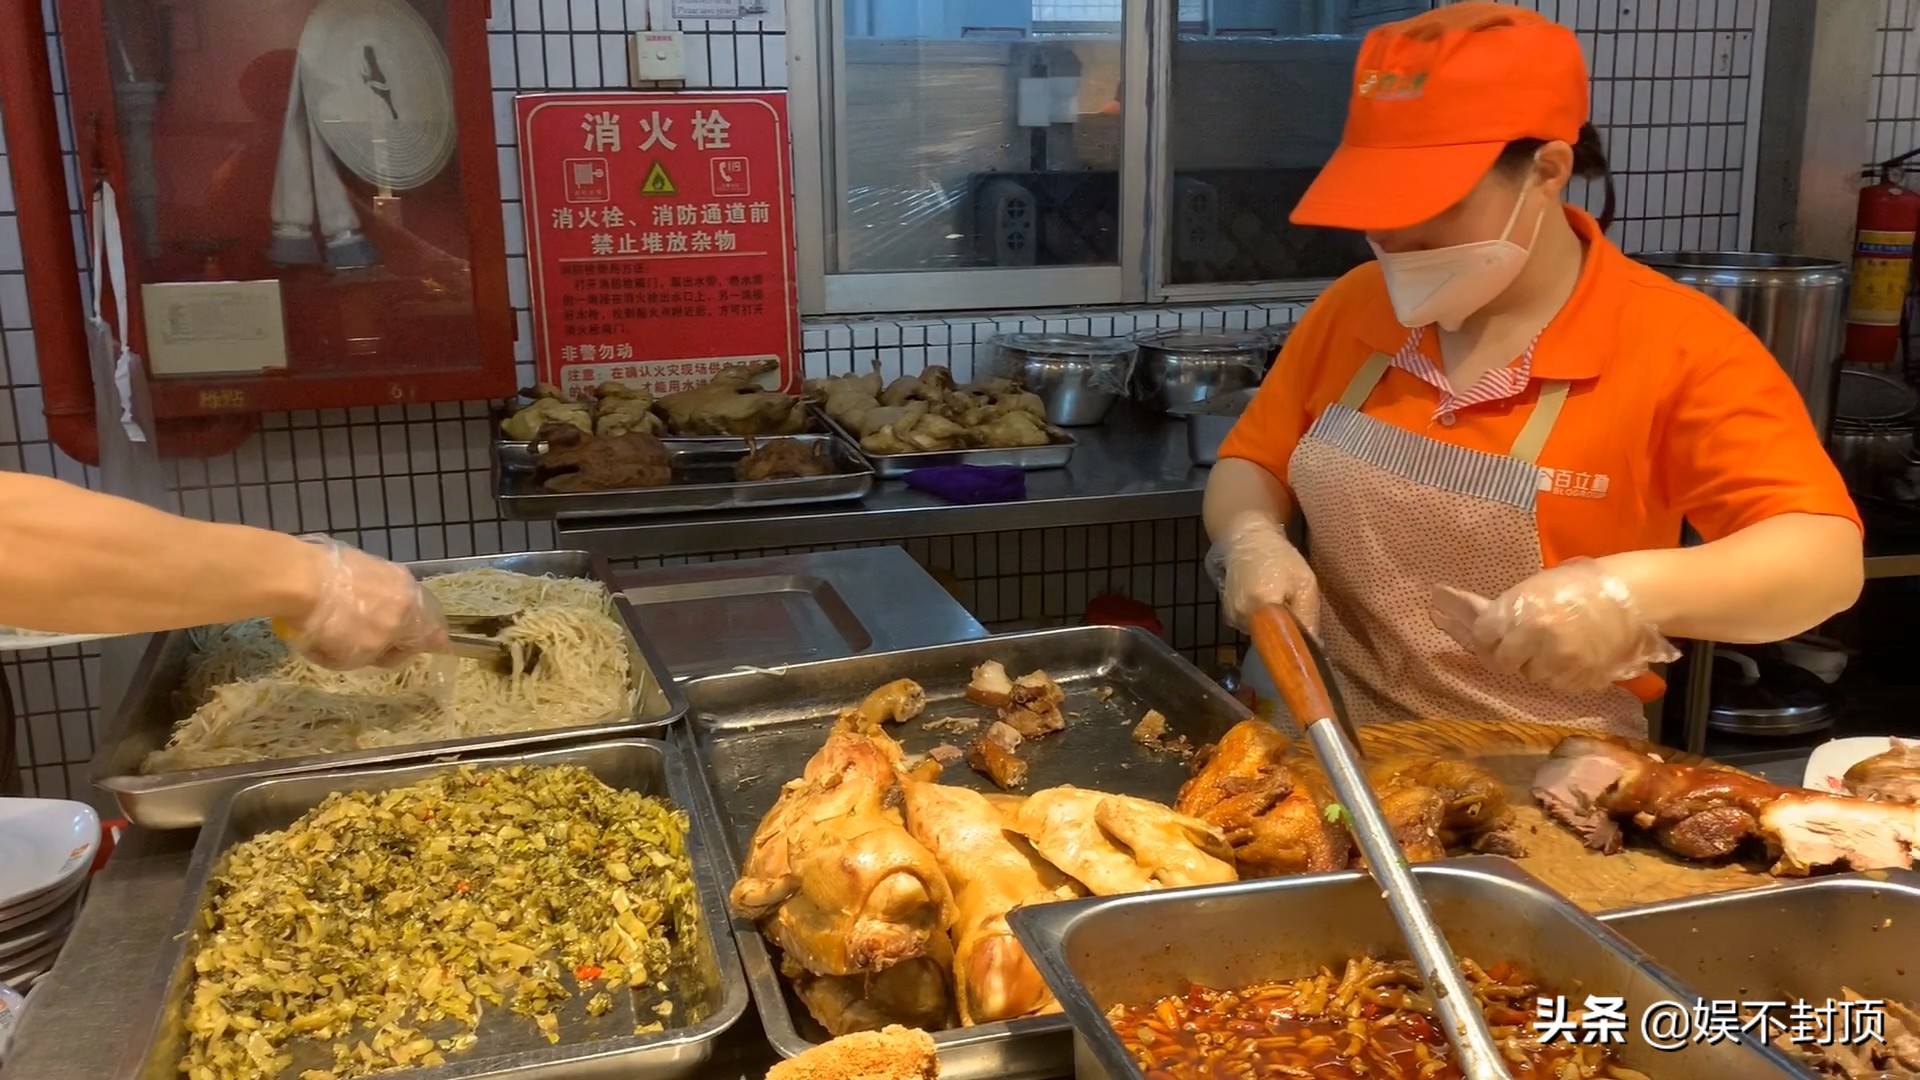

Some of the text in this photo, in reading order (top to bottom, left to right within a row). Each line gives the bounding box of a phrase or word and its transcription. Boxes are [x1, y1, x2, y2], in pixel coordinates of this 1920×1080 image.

[581, 109, 731, 153] 消火栓
[551, 202, 770, 229] 消火栓、消防通道前
[591, 231, 736, 255] 禁止堆放杂物
[561, 343, 633, 361] 非警勿动
